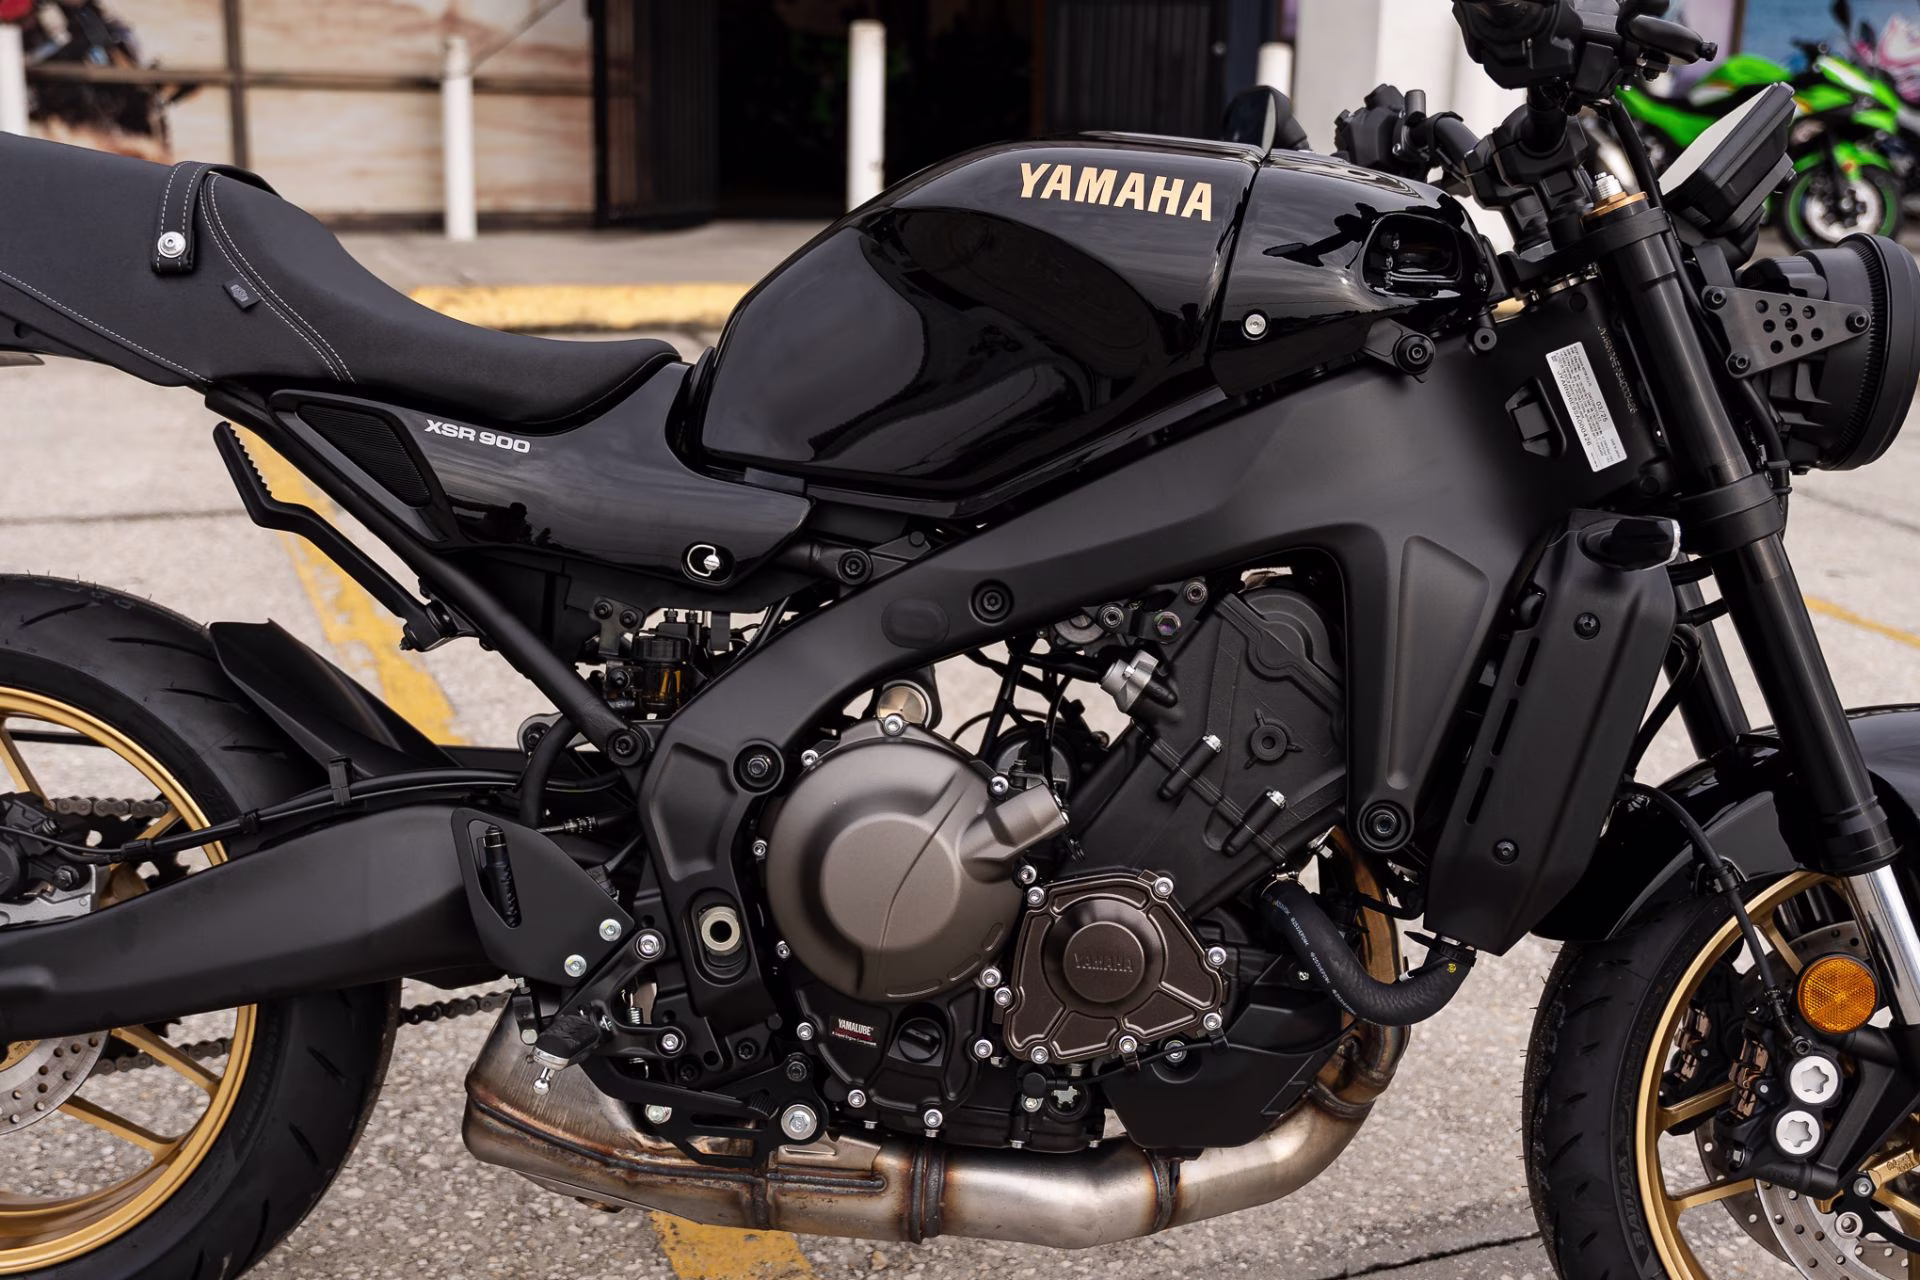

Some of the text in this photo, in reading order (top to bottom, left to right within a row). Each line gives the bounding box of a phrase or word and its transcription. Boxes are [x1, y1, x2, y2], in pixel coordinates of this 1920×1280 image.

[1020, 162, 1212, 222] YAMAHA
[1596, 401, 1608, 423] 03/25
[424, 419, 531, 454] XSR 900
[1074, 951, 1134, 973] YAMAHA
[838, 1018, 871, 1036] YAMALUBE
